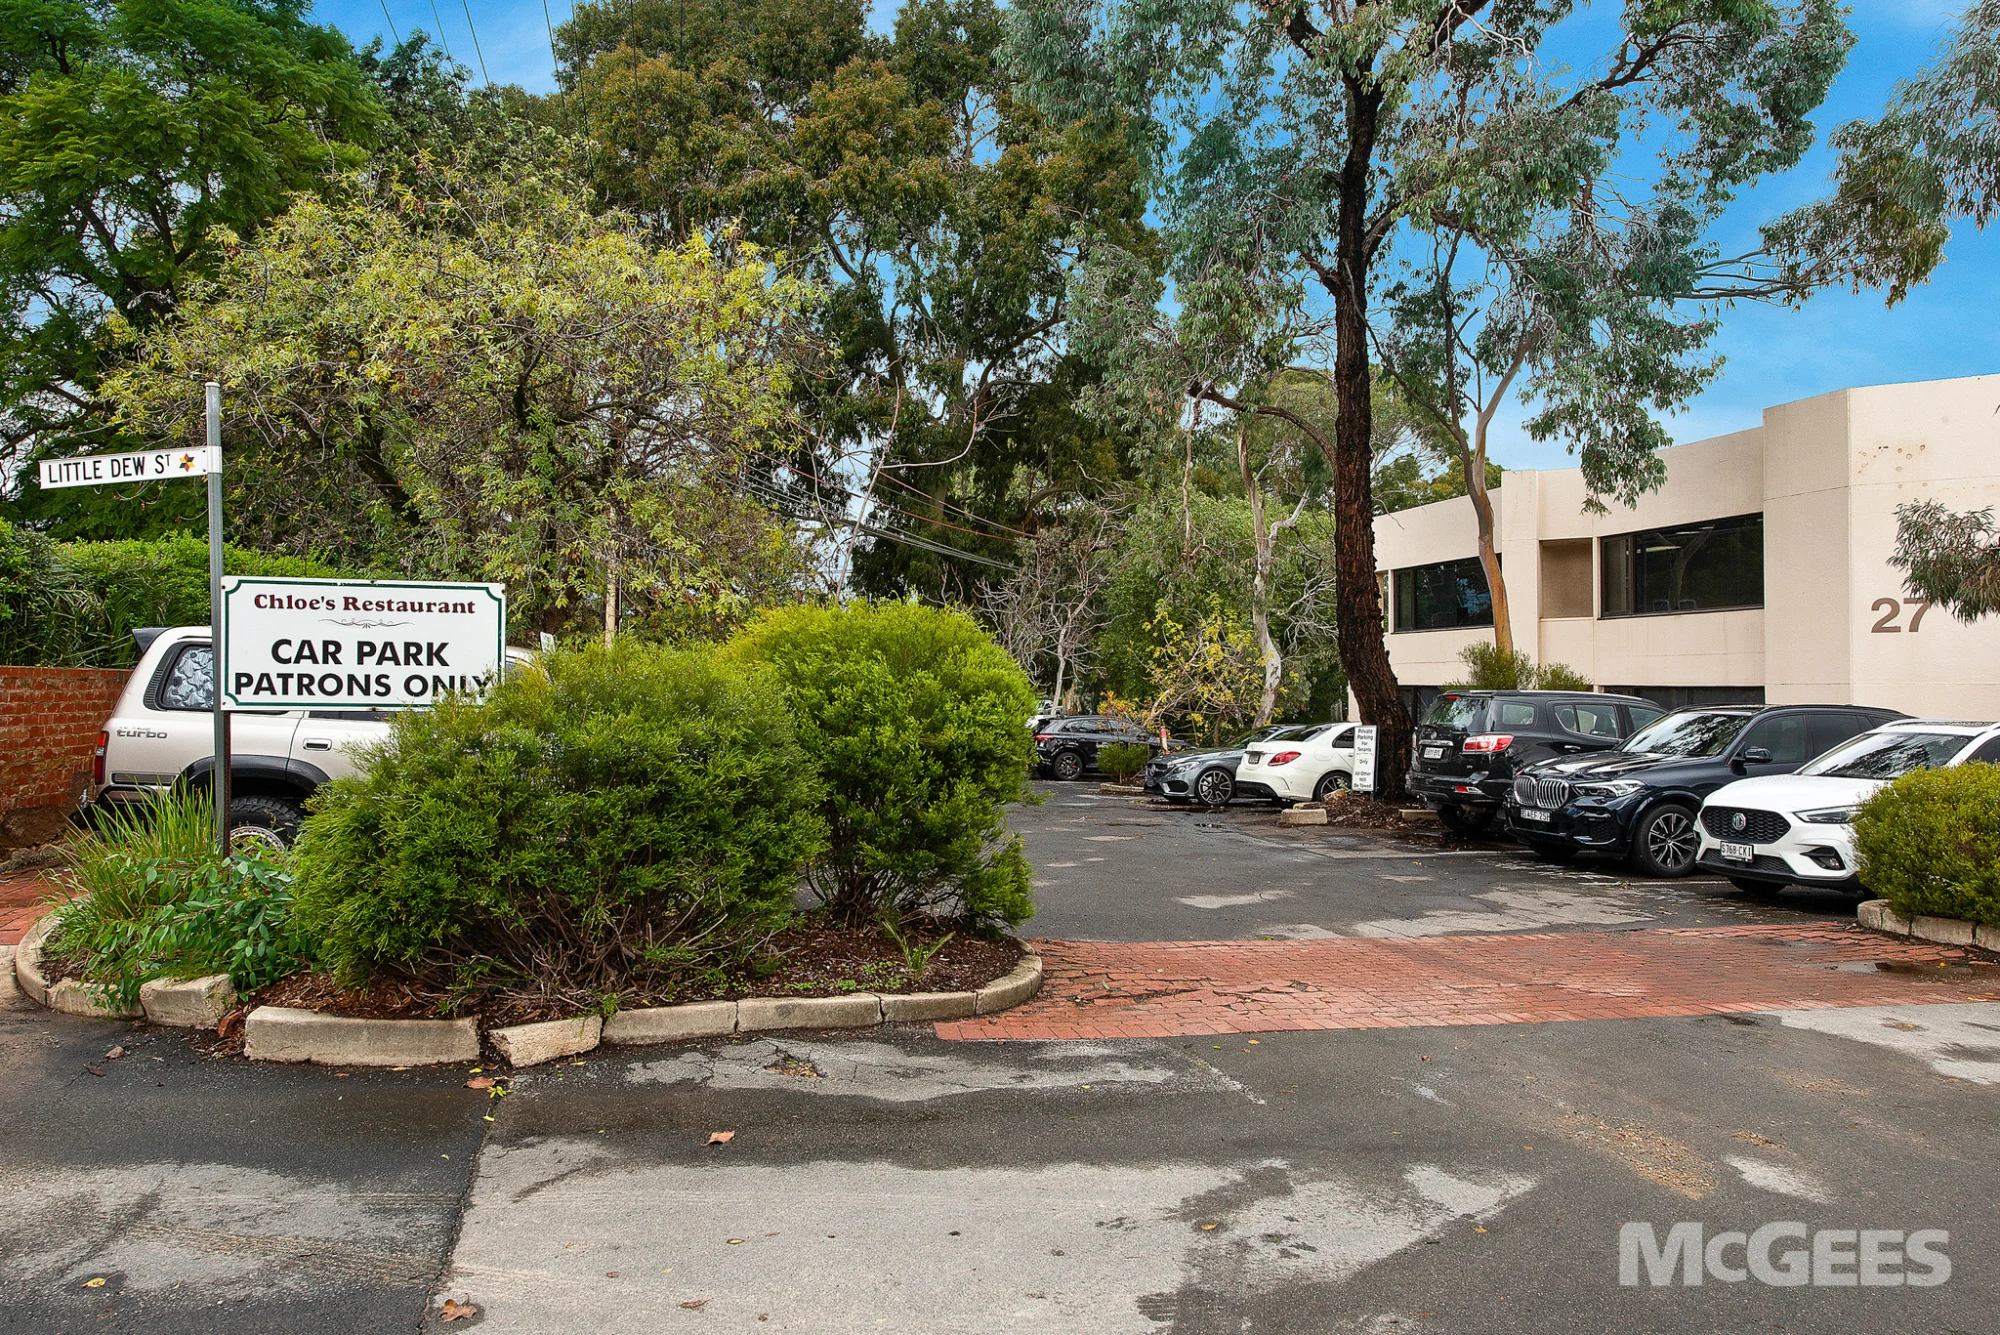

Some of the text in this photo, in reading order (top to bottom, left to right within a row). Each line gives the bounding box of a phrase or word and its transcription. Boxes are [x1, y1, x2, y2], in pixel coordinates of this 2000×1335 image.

[48, 460, 103, 483] LITTLE
[111, 456, 145, 477] DEW
[254, 594, 475, 614] Chloe's Restaurant
[1871, 597, 1931, 634] 27
[271, 638, 450, 667] CAR PARK
[234, 672, 491, 698] PATRONS ONLY
[116, 729, 168, 739] turbo
